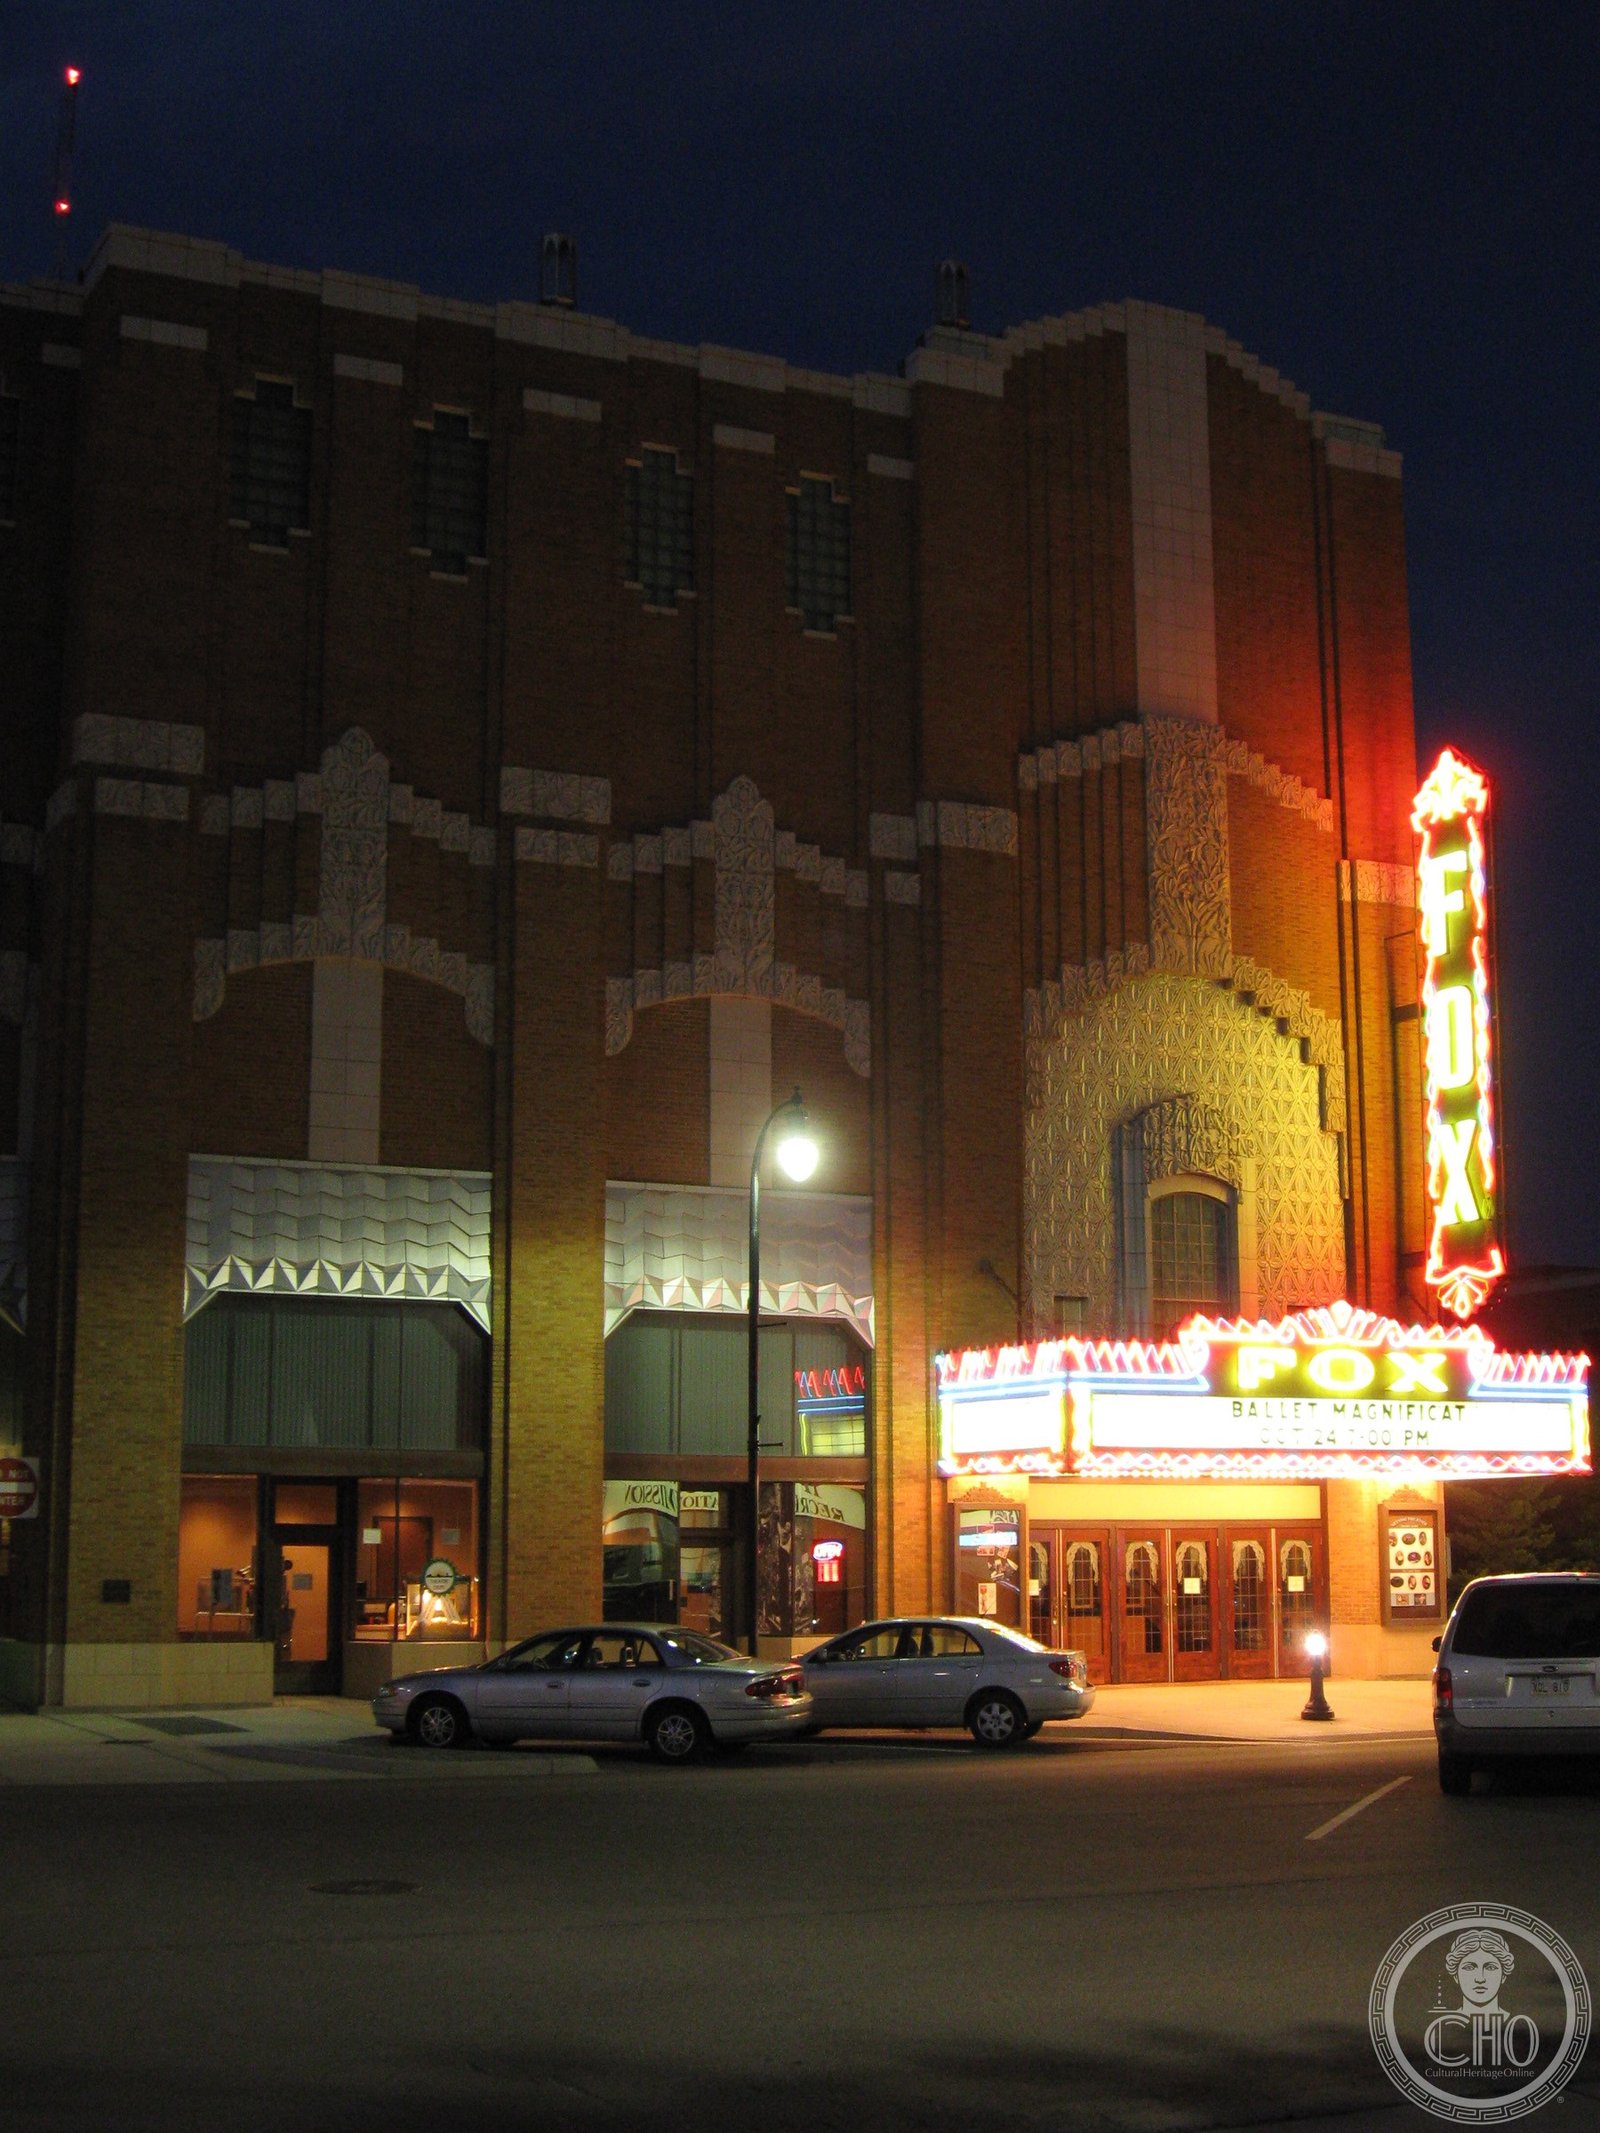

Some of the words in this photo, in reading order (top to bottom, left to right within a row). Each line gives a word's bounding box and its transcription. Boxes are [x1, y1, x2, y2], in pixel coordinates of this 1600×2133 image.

[1426, 850, 1480, 1225] FOX
[1237, 1346, 1449, 1393] FOX
[1232, 1400, 1318, 1419] BALLET
[1332, 1402, 1466, 1422] MAGNIFICAT
[1260, 1428, 1305, 1445] OCT
[1313, 1428, 1337, 1446] 24
[1403, 1430, 1430, 1446] PM
